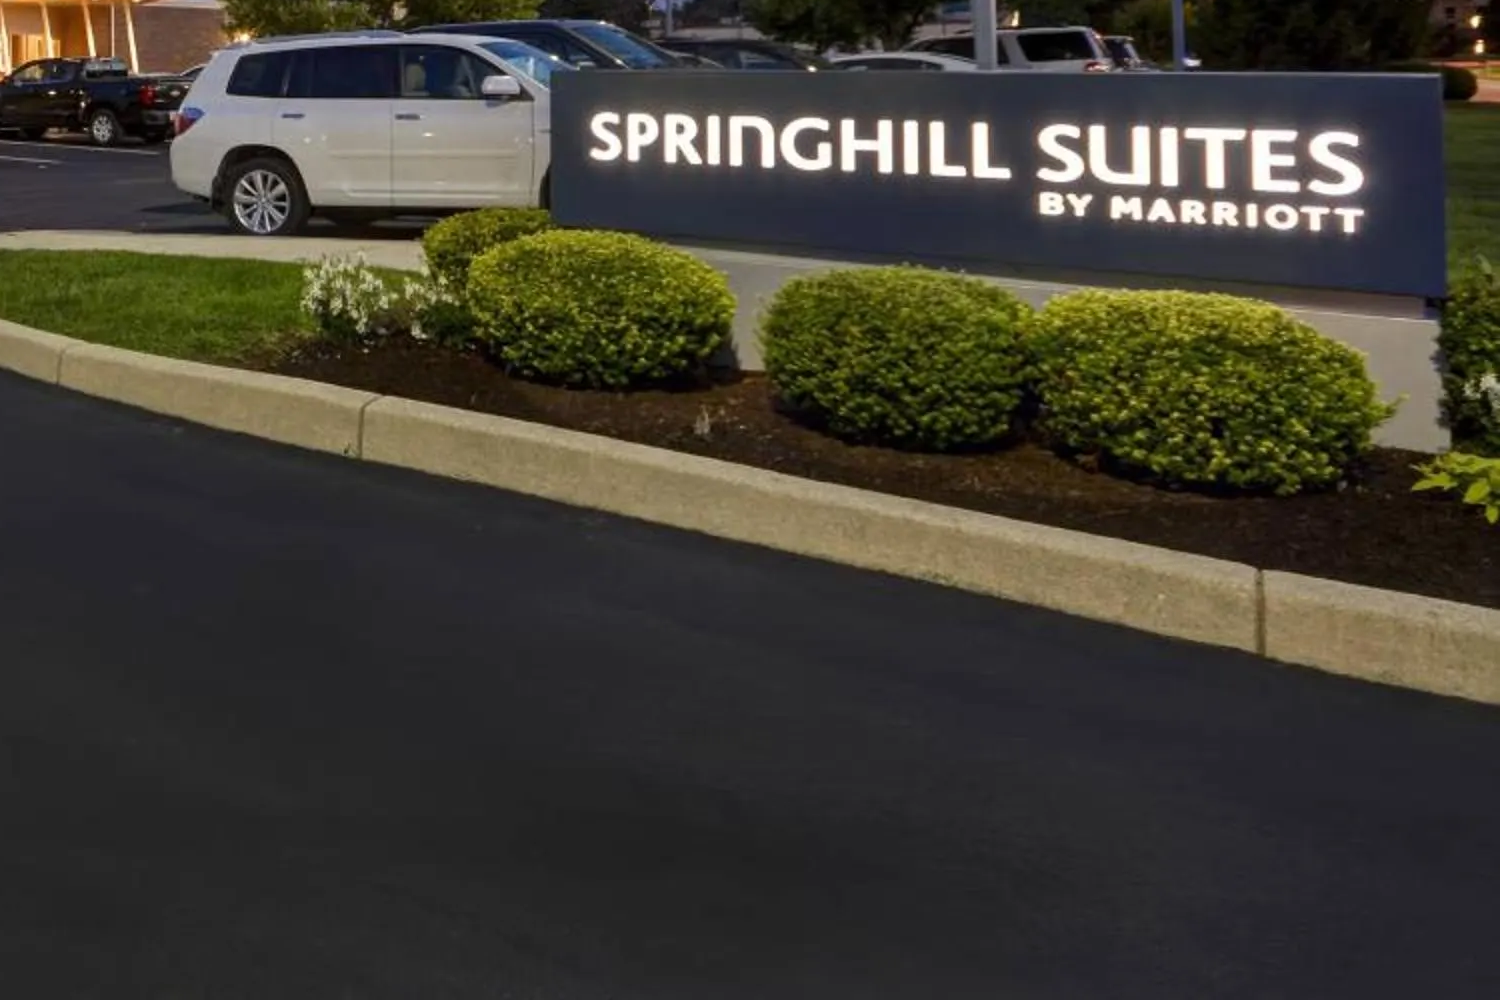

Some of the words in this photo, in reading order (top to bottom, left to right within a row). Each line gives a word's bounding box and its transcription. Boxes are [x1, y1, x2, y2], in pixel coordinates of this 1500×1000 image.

[589, 110, 1012, 180] SPRINGHILL
[1036, 123, 1365, 196] SUITES
[1038, 190, 1094, 218] BY
[1109, 194, 1366, 234] MARRIOTT
